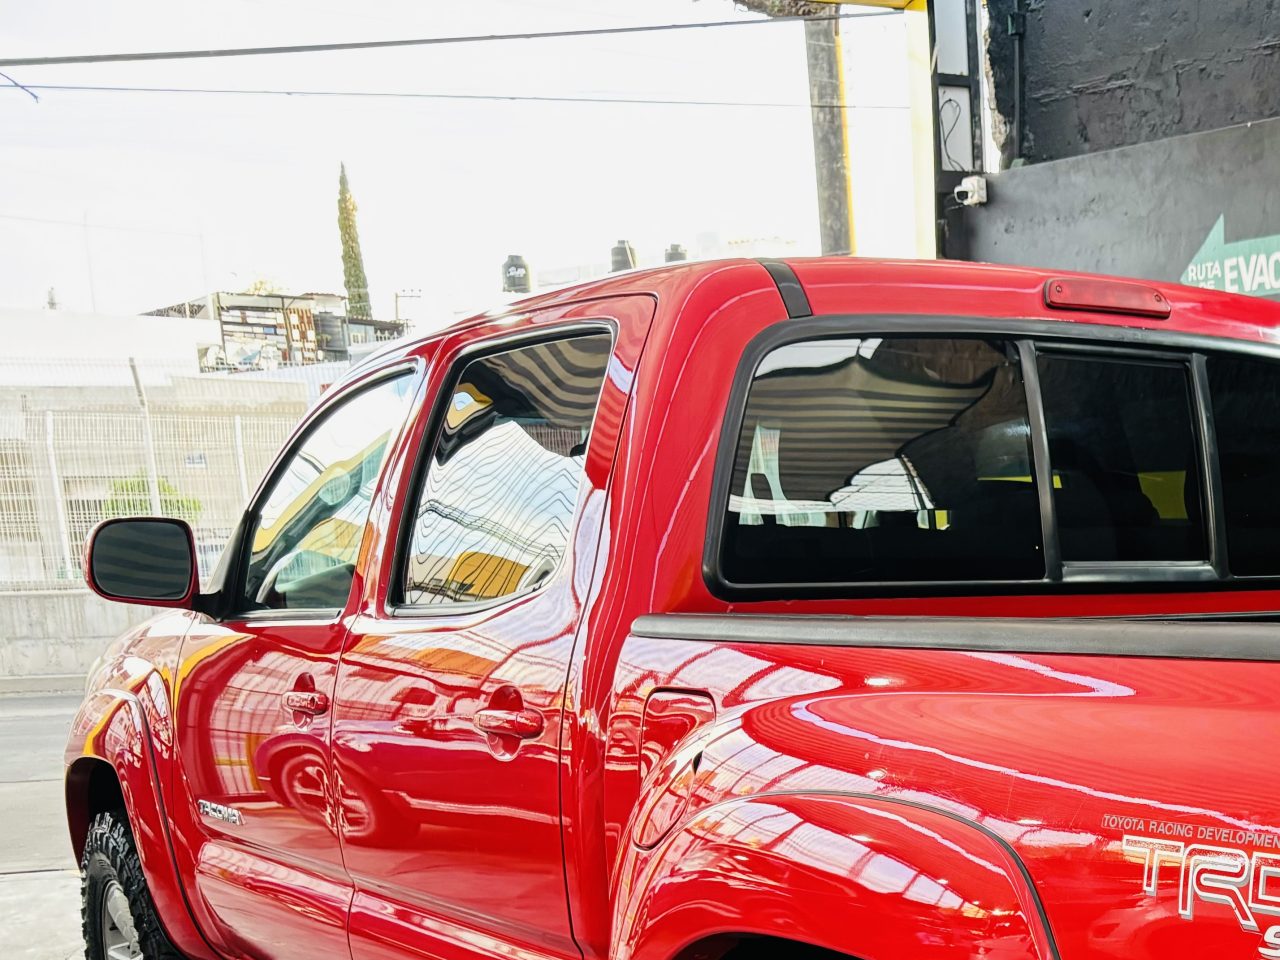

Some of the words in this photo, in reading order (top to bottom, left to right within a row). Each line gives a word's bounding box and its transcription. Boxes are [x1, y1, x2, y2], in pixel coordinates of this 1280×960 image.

[1188, 260, 1222, 282] RUTA
[1102, 814, 1145, 832] TOYOTA
[1148, 820, 1194, 839] RACING
